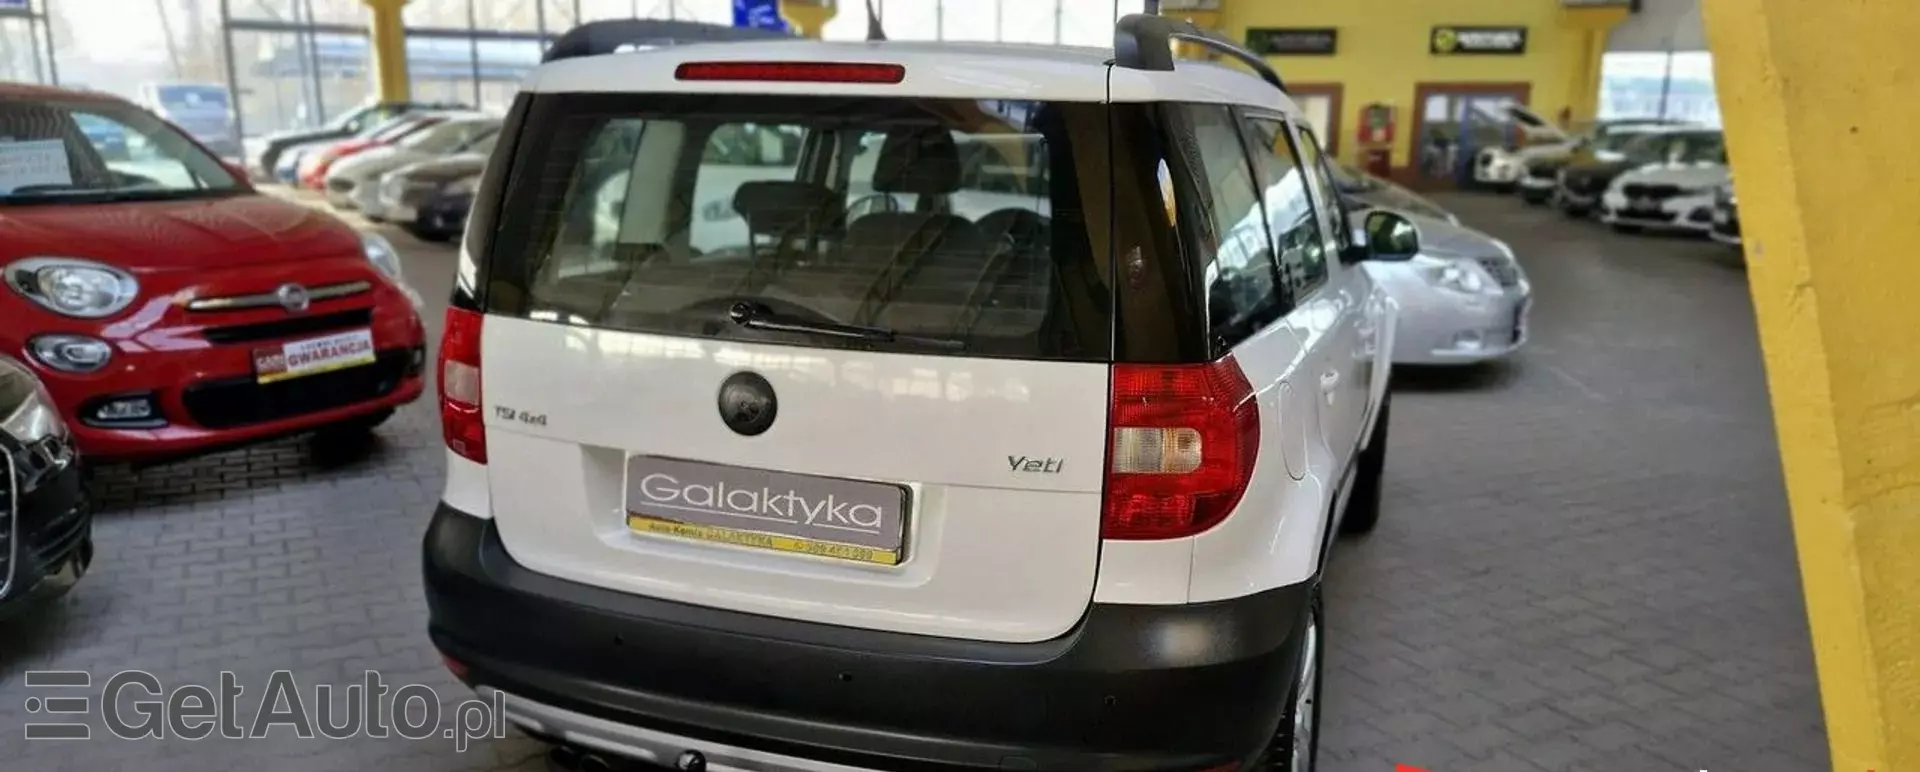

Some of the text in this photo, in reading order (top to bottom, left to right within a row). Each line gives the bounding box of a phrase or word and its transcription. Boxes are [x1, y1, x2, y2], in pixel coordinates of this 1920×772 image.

[287, 339, 370, 368] GWARANCJA
[495, 405, 548, 426] TSI 4x4
[1007, 455, 1064, 474] Yeti
[640, 472, 882, 528] Galaktyka
